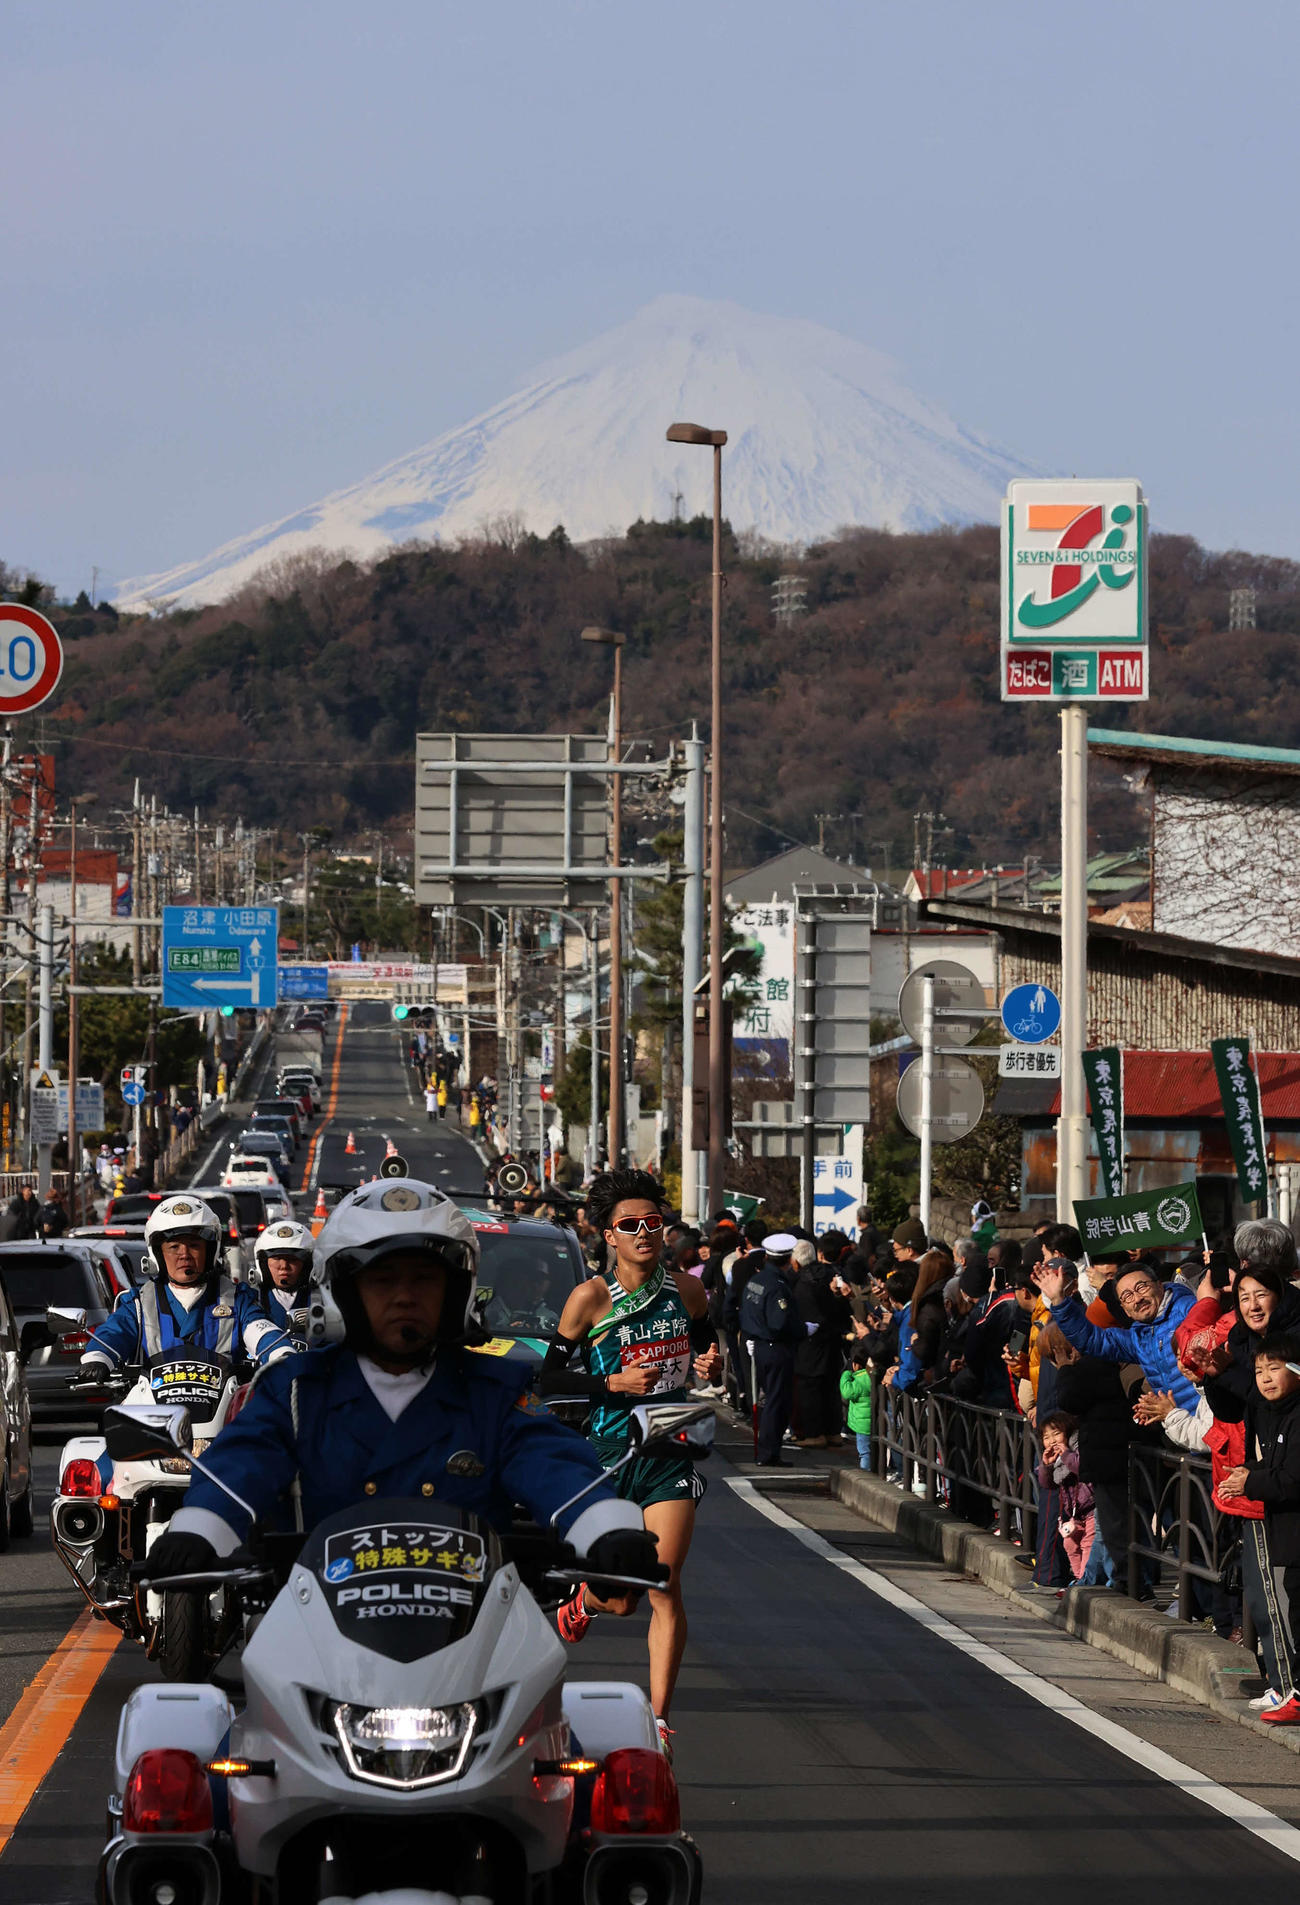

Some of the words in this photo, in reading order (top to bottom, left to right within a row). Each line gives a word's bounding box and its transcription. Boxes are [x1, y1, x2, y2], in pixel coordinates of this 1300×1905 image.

[1072, 550, 1134, 563] HOLDINGS
[0, 635, 36, 682] 0
[1009, 659, 1050, 688] たばこ
[1061, 659, 1089, 688] 酒
[1101, 659, 1140, 688] ATM
[183, 910, 216, 926] 沼津
[224, 910, 271, 926] 小田原
[173, 953, 199, 965] E84
[1006, 1051, 1056, 1071] 歩行者優先
[615, 1317, 689, 1347] 青山学院
[639, 1340, 689, 1358] SAPPORO
[163, 1371, 210, 1384] 特殊サギ
[157, 1387, 219, 1399] POLICE
[166, 1396, 212, 1405] HONDA
[351, 1529, 464, 1552] ストップ！
[355, 1546, 460, 1570] 特殊サギ
[337, 1583, 473, 1606] POLICE
[356, 1603, 456, 1620] HONDA
